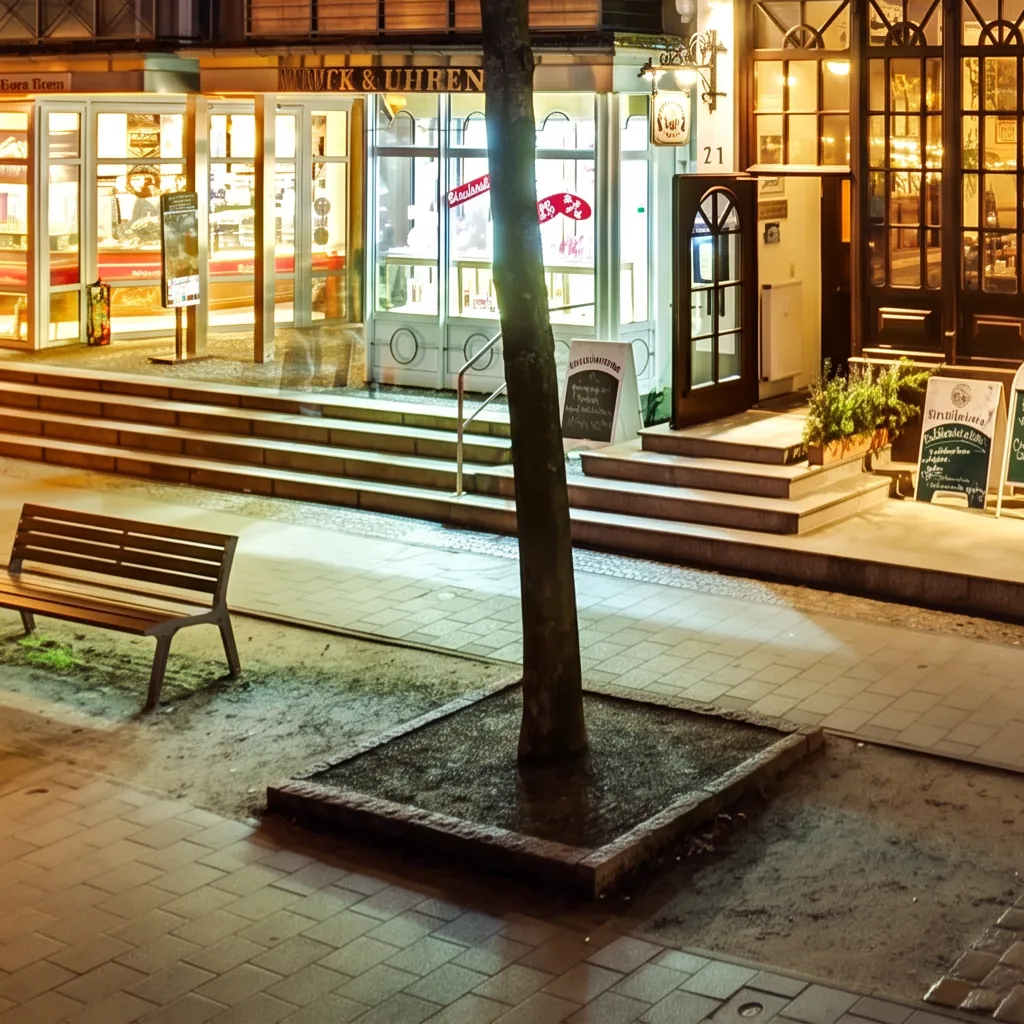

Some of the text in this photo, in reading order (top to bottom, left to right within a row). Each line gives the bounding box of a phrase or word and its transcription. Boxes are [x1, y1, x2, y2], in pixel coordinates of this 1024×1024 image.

[362, 69, 377, 91] &
[384, 68, 485, 92] UHREN
[703, 145, 724, 165] 21
